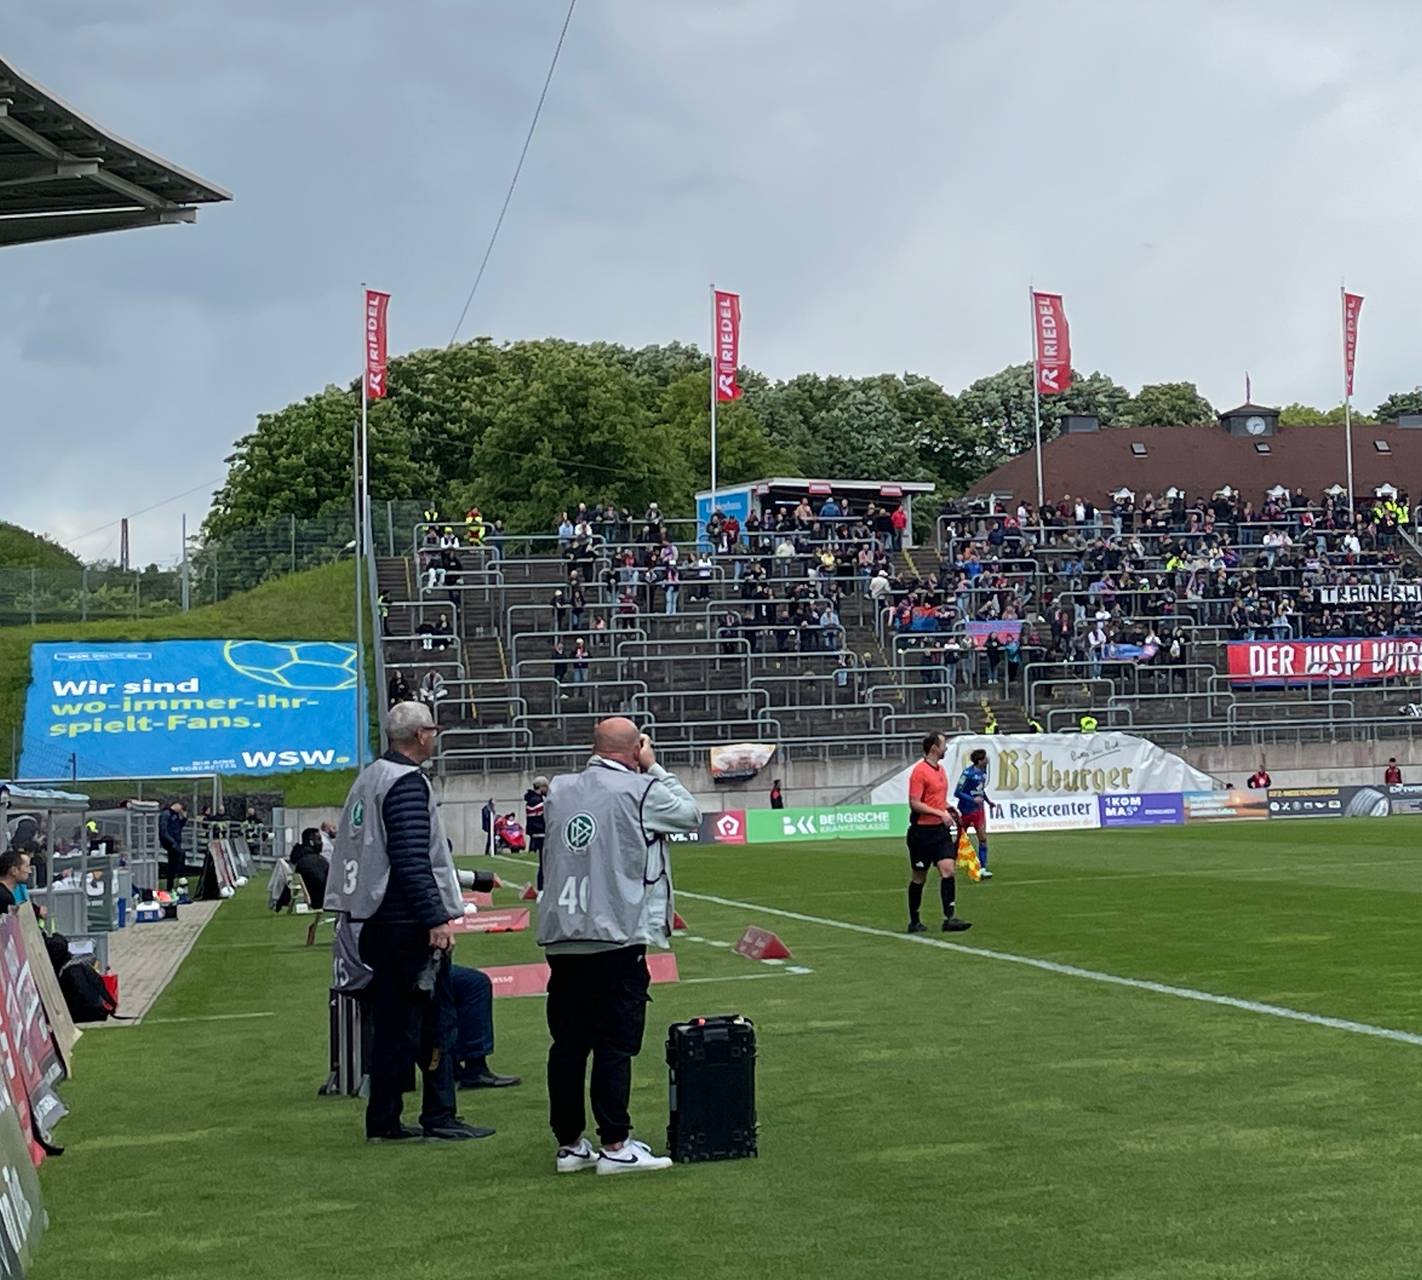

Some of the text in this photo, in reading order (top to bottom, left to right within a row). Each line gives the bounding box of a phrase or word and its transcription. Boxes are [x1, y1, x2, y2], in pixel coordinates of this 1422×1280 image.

[720, 298, 733, 361] RIEDEL
[1039, 297, 1058, 355] RIEDEL
[1249, 645, 1294, 676] DER
[52, 678, 199, 697] Wir sind
[51, 694, 319, 717] wo-immer-ihr-
[50, 714, 261, 738] spielt-Fans.
[995, 749, 1133, 796] Bitburger
[820, 811, 889, 825] BERGISCHE
[1010, 803, 1092, 819] Reisecenter
